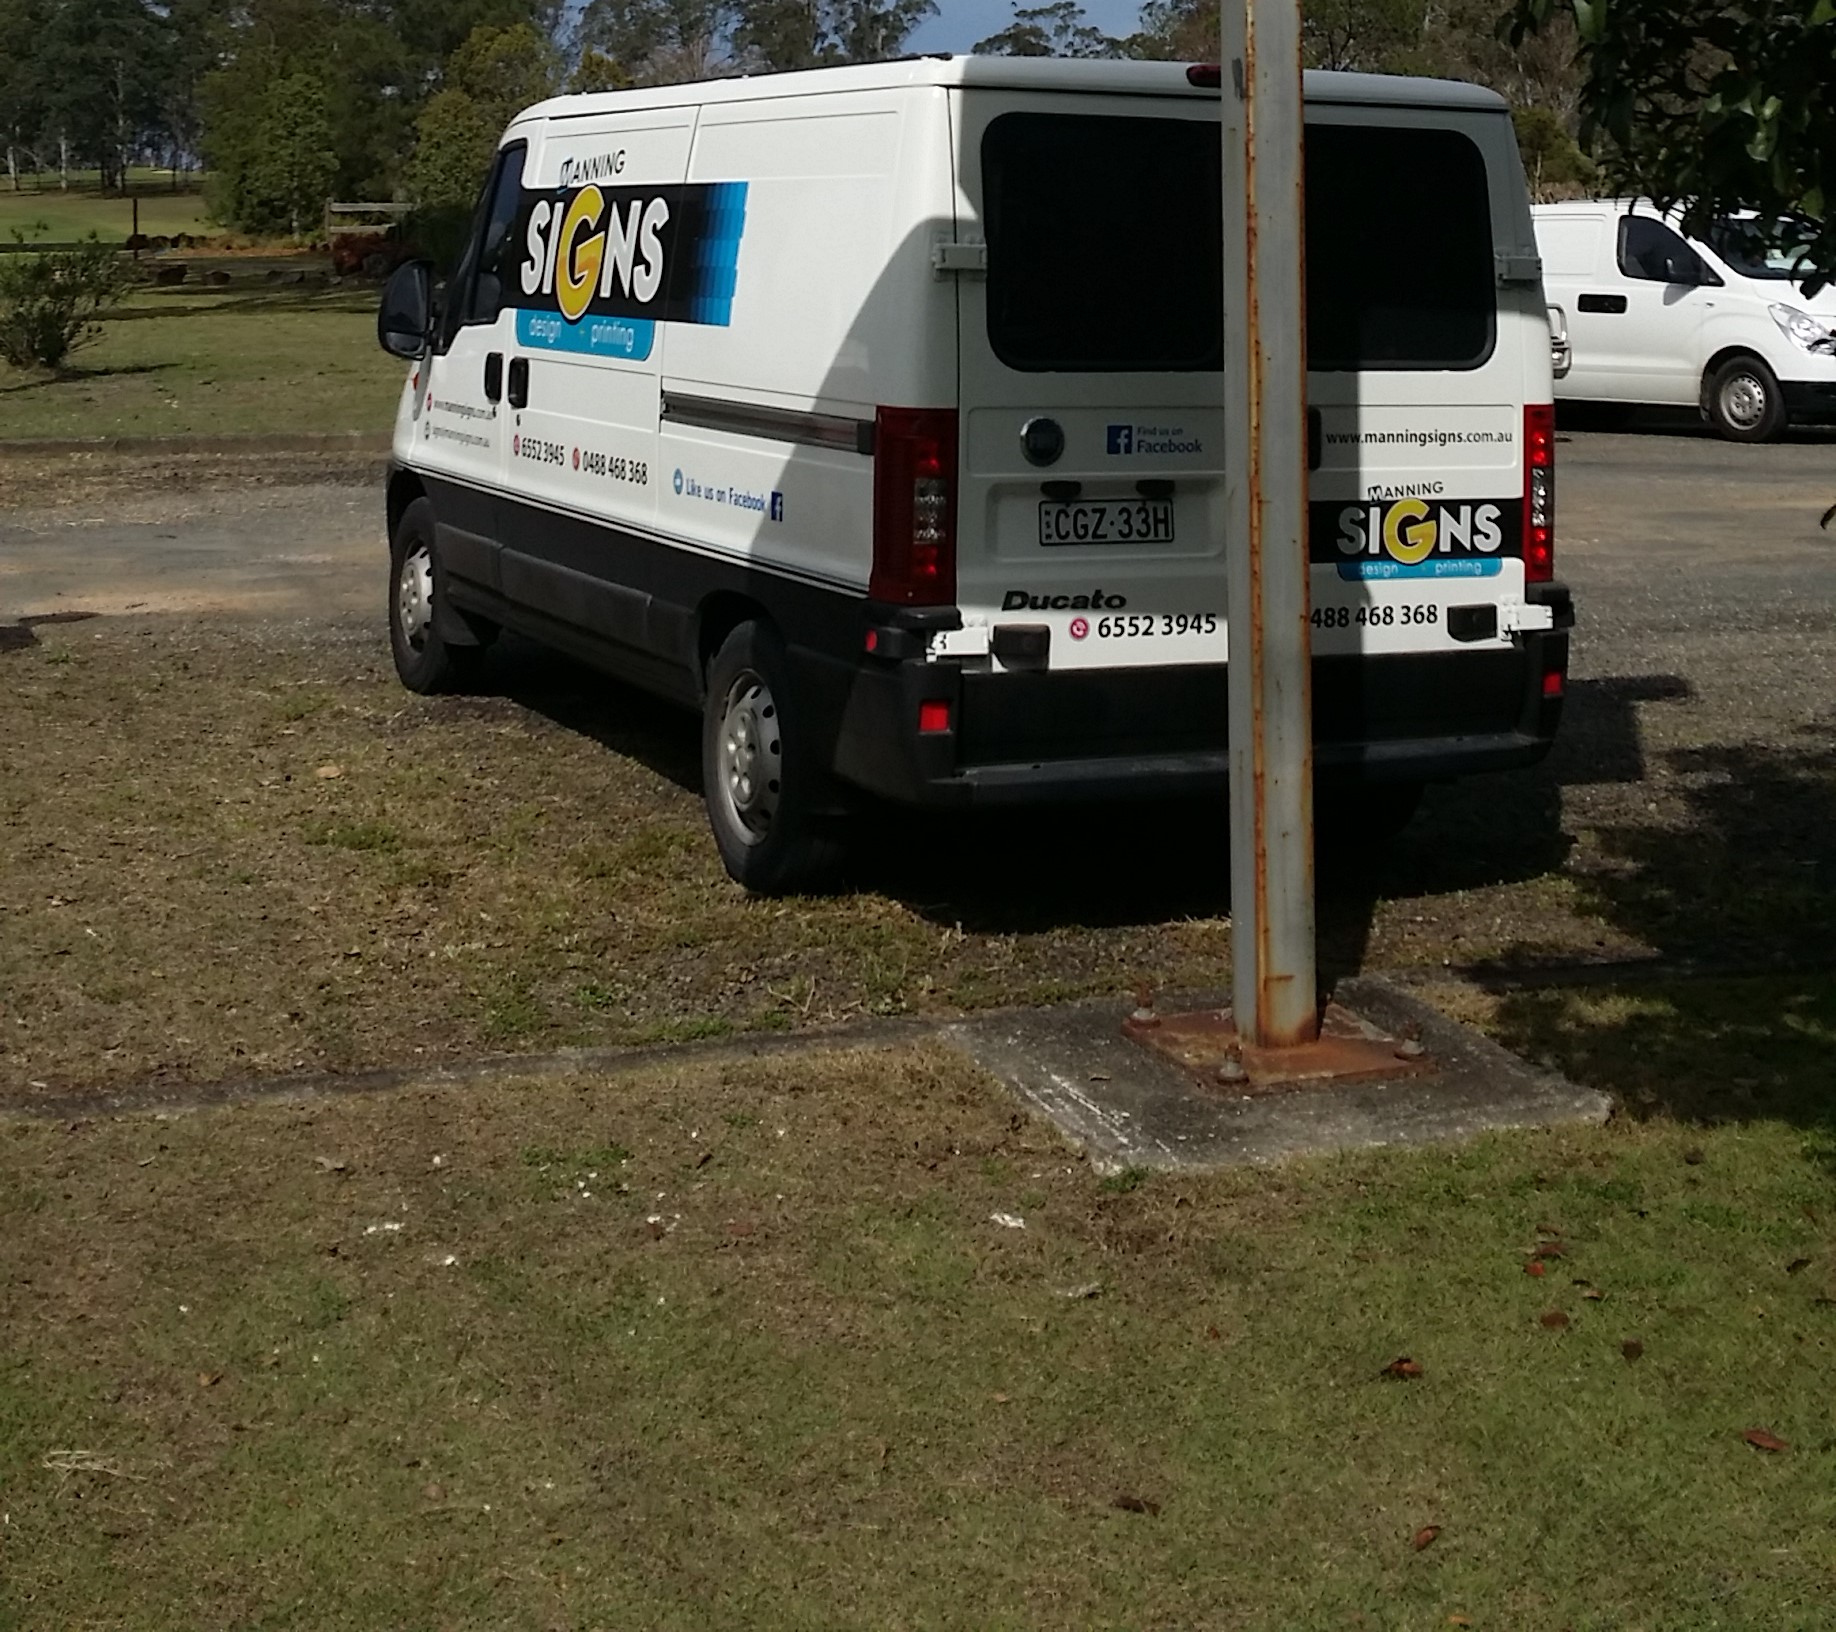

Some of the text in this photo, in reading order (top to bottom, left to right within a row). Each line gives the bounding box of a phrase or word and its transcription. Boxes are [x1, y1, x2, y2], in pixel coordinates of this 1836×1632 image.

[520, 184, 671, 321] SIGNS
[591, 320, 634, 353] printing
[1137, 438, 1203, 454] Facebook
[1325, 428, 1513, 447] www.manningsigns.com.au
[608, 456, 626, 481] 468
[628, 460, 648, 485] 368
[729, 487, 766, 511] Facebook
[1367, 481, 1444, 503] MANNING
[1337, 498, 1502, 564] SIGNS
[1435, 560, 1482, 575] printing
[1001, 590, 1127, 611] Ducato
[1098, 613, 1217, 638] 6552 3945
[1310, 604, 1438, 628] 488 468 368
